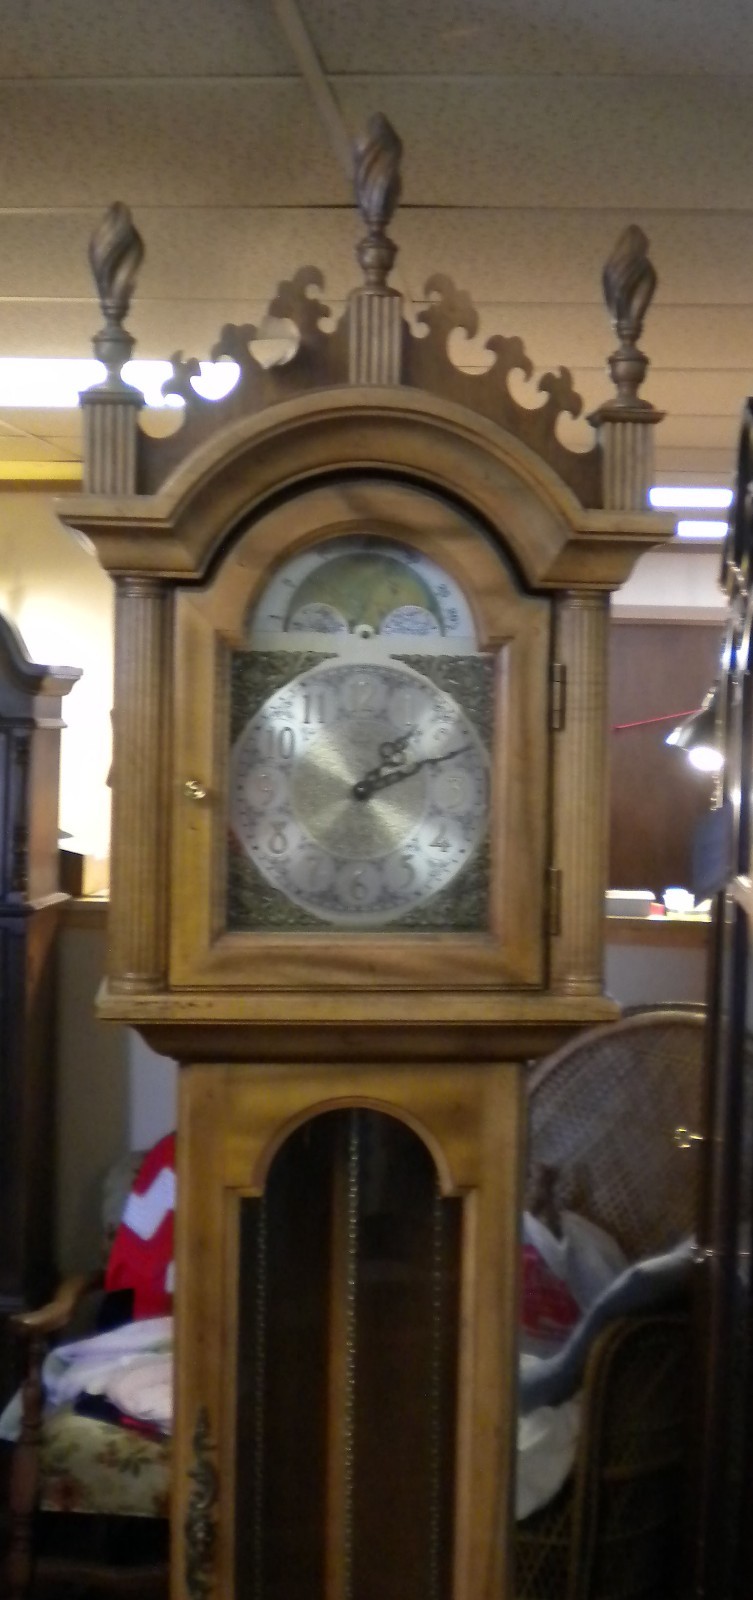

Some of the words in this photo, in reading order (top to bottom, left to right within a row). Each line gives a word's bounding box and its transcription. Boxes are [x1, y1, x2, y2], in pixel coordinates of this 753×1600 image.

[303, 694, 326, 724] 11
[265, 726, 296, 760] 10
[269, 821, 288, 854] 8
[428, 823, 452, 853] 4
[350, 869, 369, 900] 6
